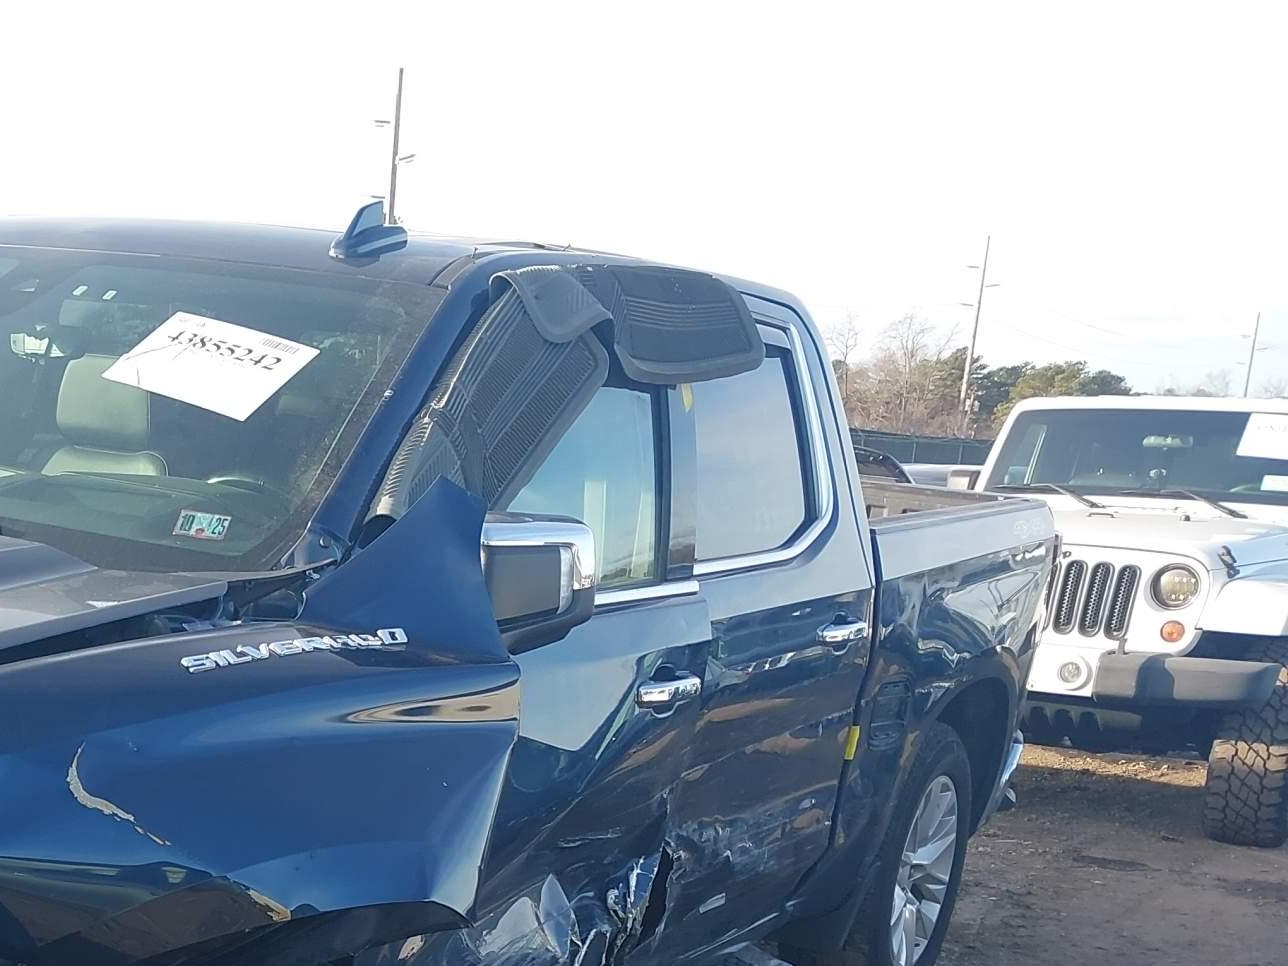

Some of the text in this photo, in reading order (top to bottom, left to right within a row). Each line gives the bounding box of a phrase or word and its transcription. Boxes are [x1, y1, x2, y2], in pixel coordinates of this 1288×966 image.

[168, 330, 283, 371] 43855242
[180, 513, 228, 536] 10 25
